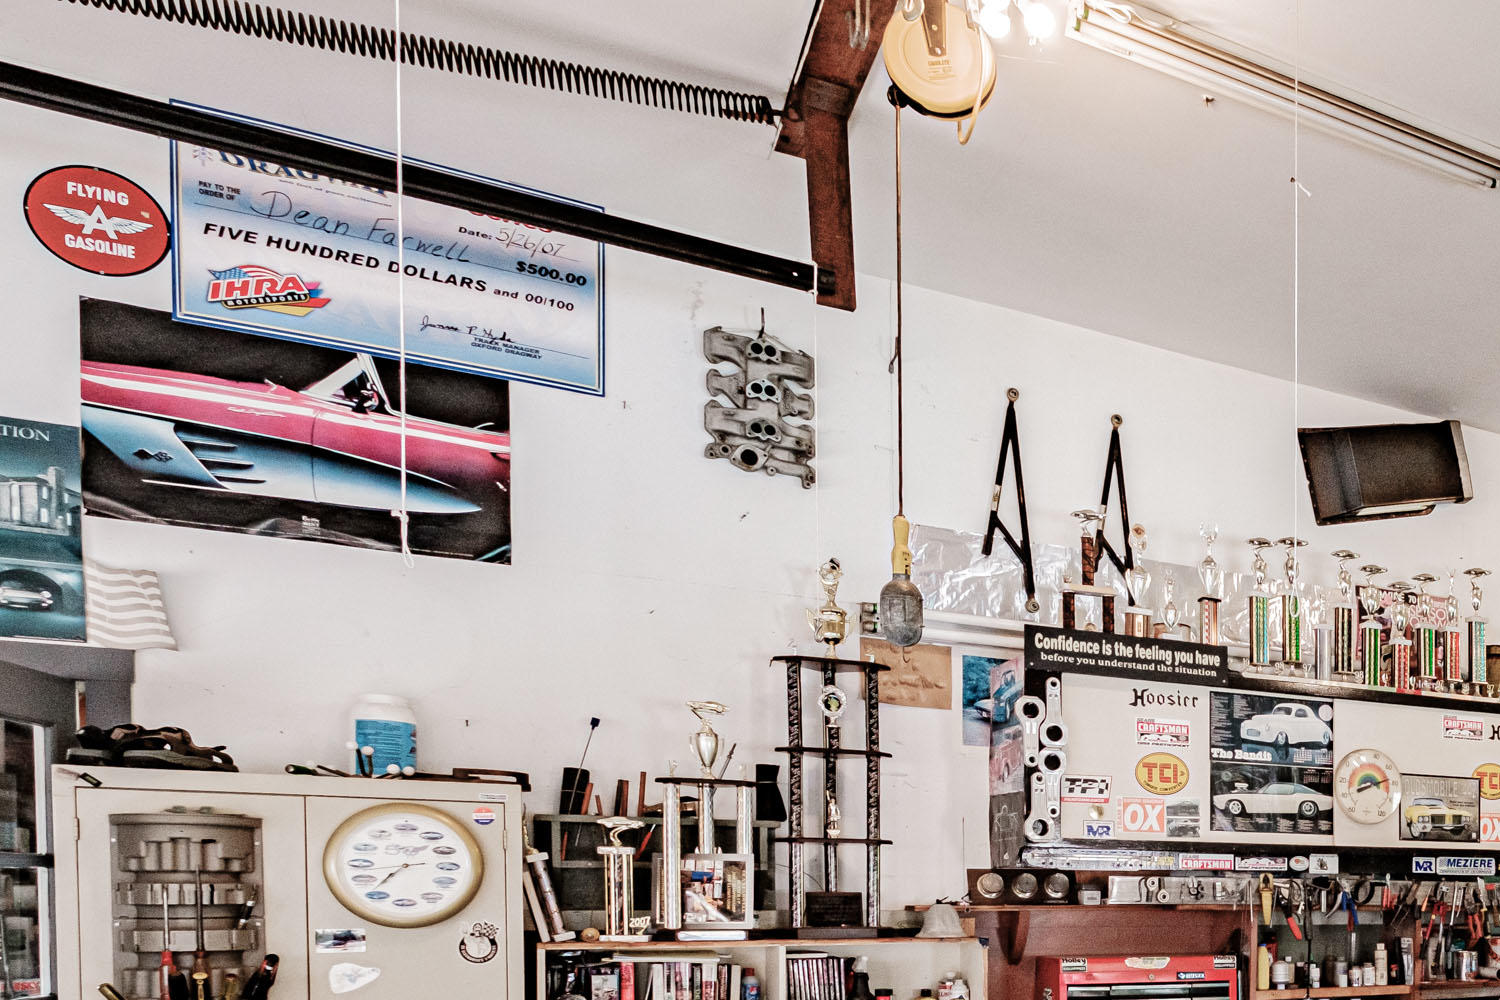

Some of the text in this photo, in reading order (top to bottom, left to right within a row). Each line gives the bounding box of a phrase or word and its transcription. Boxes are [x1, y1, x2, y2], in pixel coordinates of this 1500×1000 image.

[66, 181, 129, 206] FLYING
[198, 188, 236, 201] ORDER OF
[199, 180, 241, 195] PAY TO THE
[250, 190, 349, 235] Dean
[458, 226, 493, 240] Date:
[64, 233, 136, 259] GASOLINE
[203, 222, 259, 244] FIVE
[266, 235, 380, 269] HUNDRED
[387, 260, 488, 292] DOLLARS
[493, 287, 519, 299] and
[516, 260, 587, 286] $500.00
[209, 274, 306, 301] IHRA
[227, 294, 306, 306] MOTORSPORTS
[470, 342, 543, 360] OXFORD DRAGWAY
[473, 336, 540, 354] TRACK MANAGER
[1034, 632, 1221, 667] Confidence is the feeling you have
[1040, 652, 1217, 677] before you understand the situation
[1137, 721, 1189, 735] CRAFTSMAN
[1211, 748, 1273, 762] The Bandit
[1141, 762, 1179, 784] TCI
[1065, 777, 1109, 795] TPI
[1404, 778, 1459, 798] OLDSMOBILE
[1124, 803, 1164, 832] OX
[1182, 858, 1232, 870] CRAFTSMAN
[1446, 858, 1493, 868] MEZIERE
[629, 916, 651, 928] 2007
